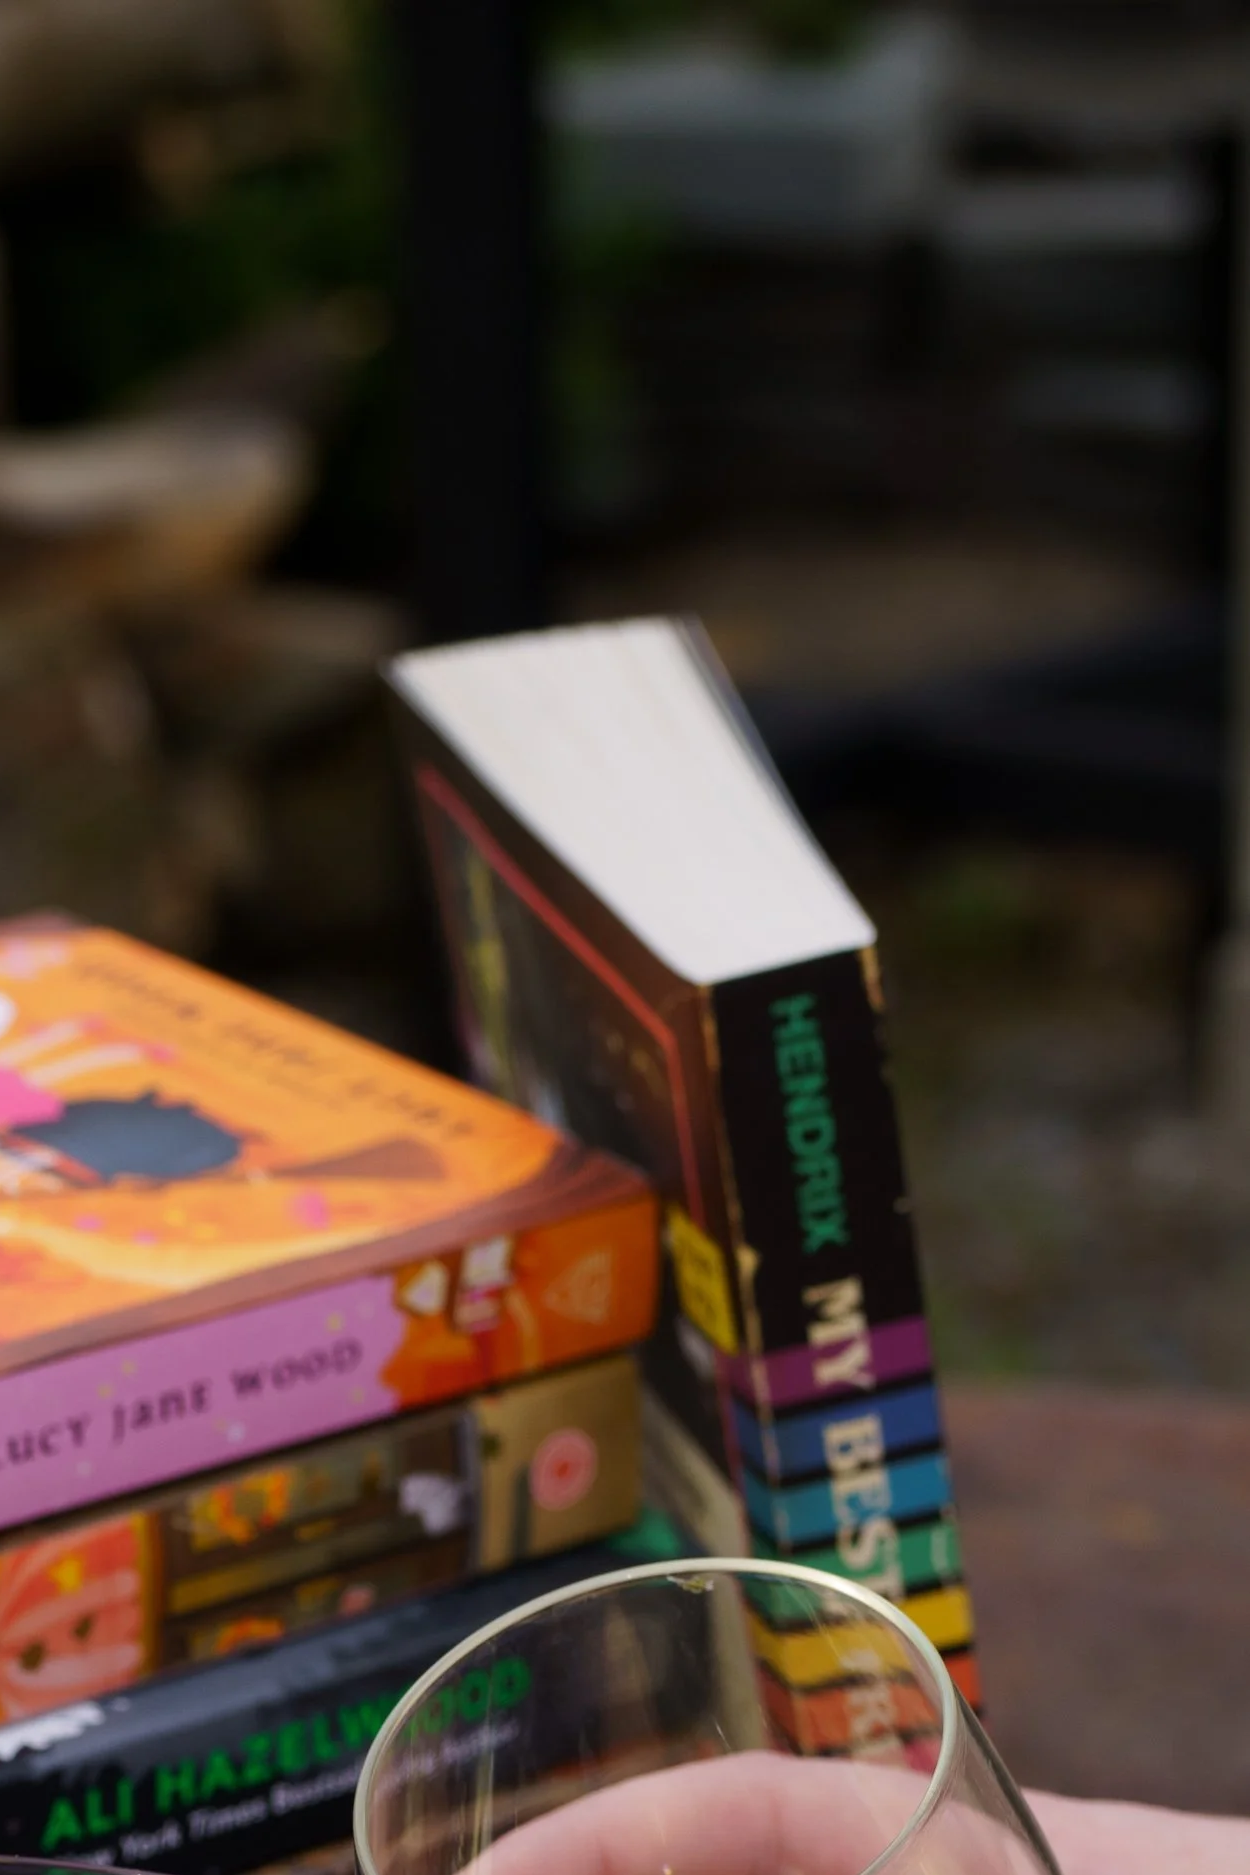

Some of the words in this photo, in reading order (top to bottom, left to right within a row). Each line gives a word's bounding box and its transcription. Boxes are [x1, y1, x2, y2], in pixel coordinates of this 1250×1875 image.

[772, 995, 851, 1254] HENDRIX
[228, 1337, 363, 1402] WOOD
[803, 1276, 875, 1391] MY
[823, 1414, 905, 1604] BEST
[40, 1776, 137, 1851] ALI
[154, 1656, 534, 1813] HAZELWOOD
